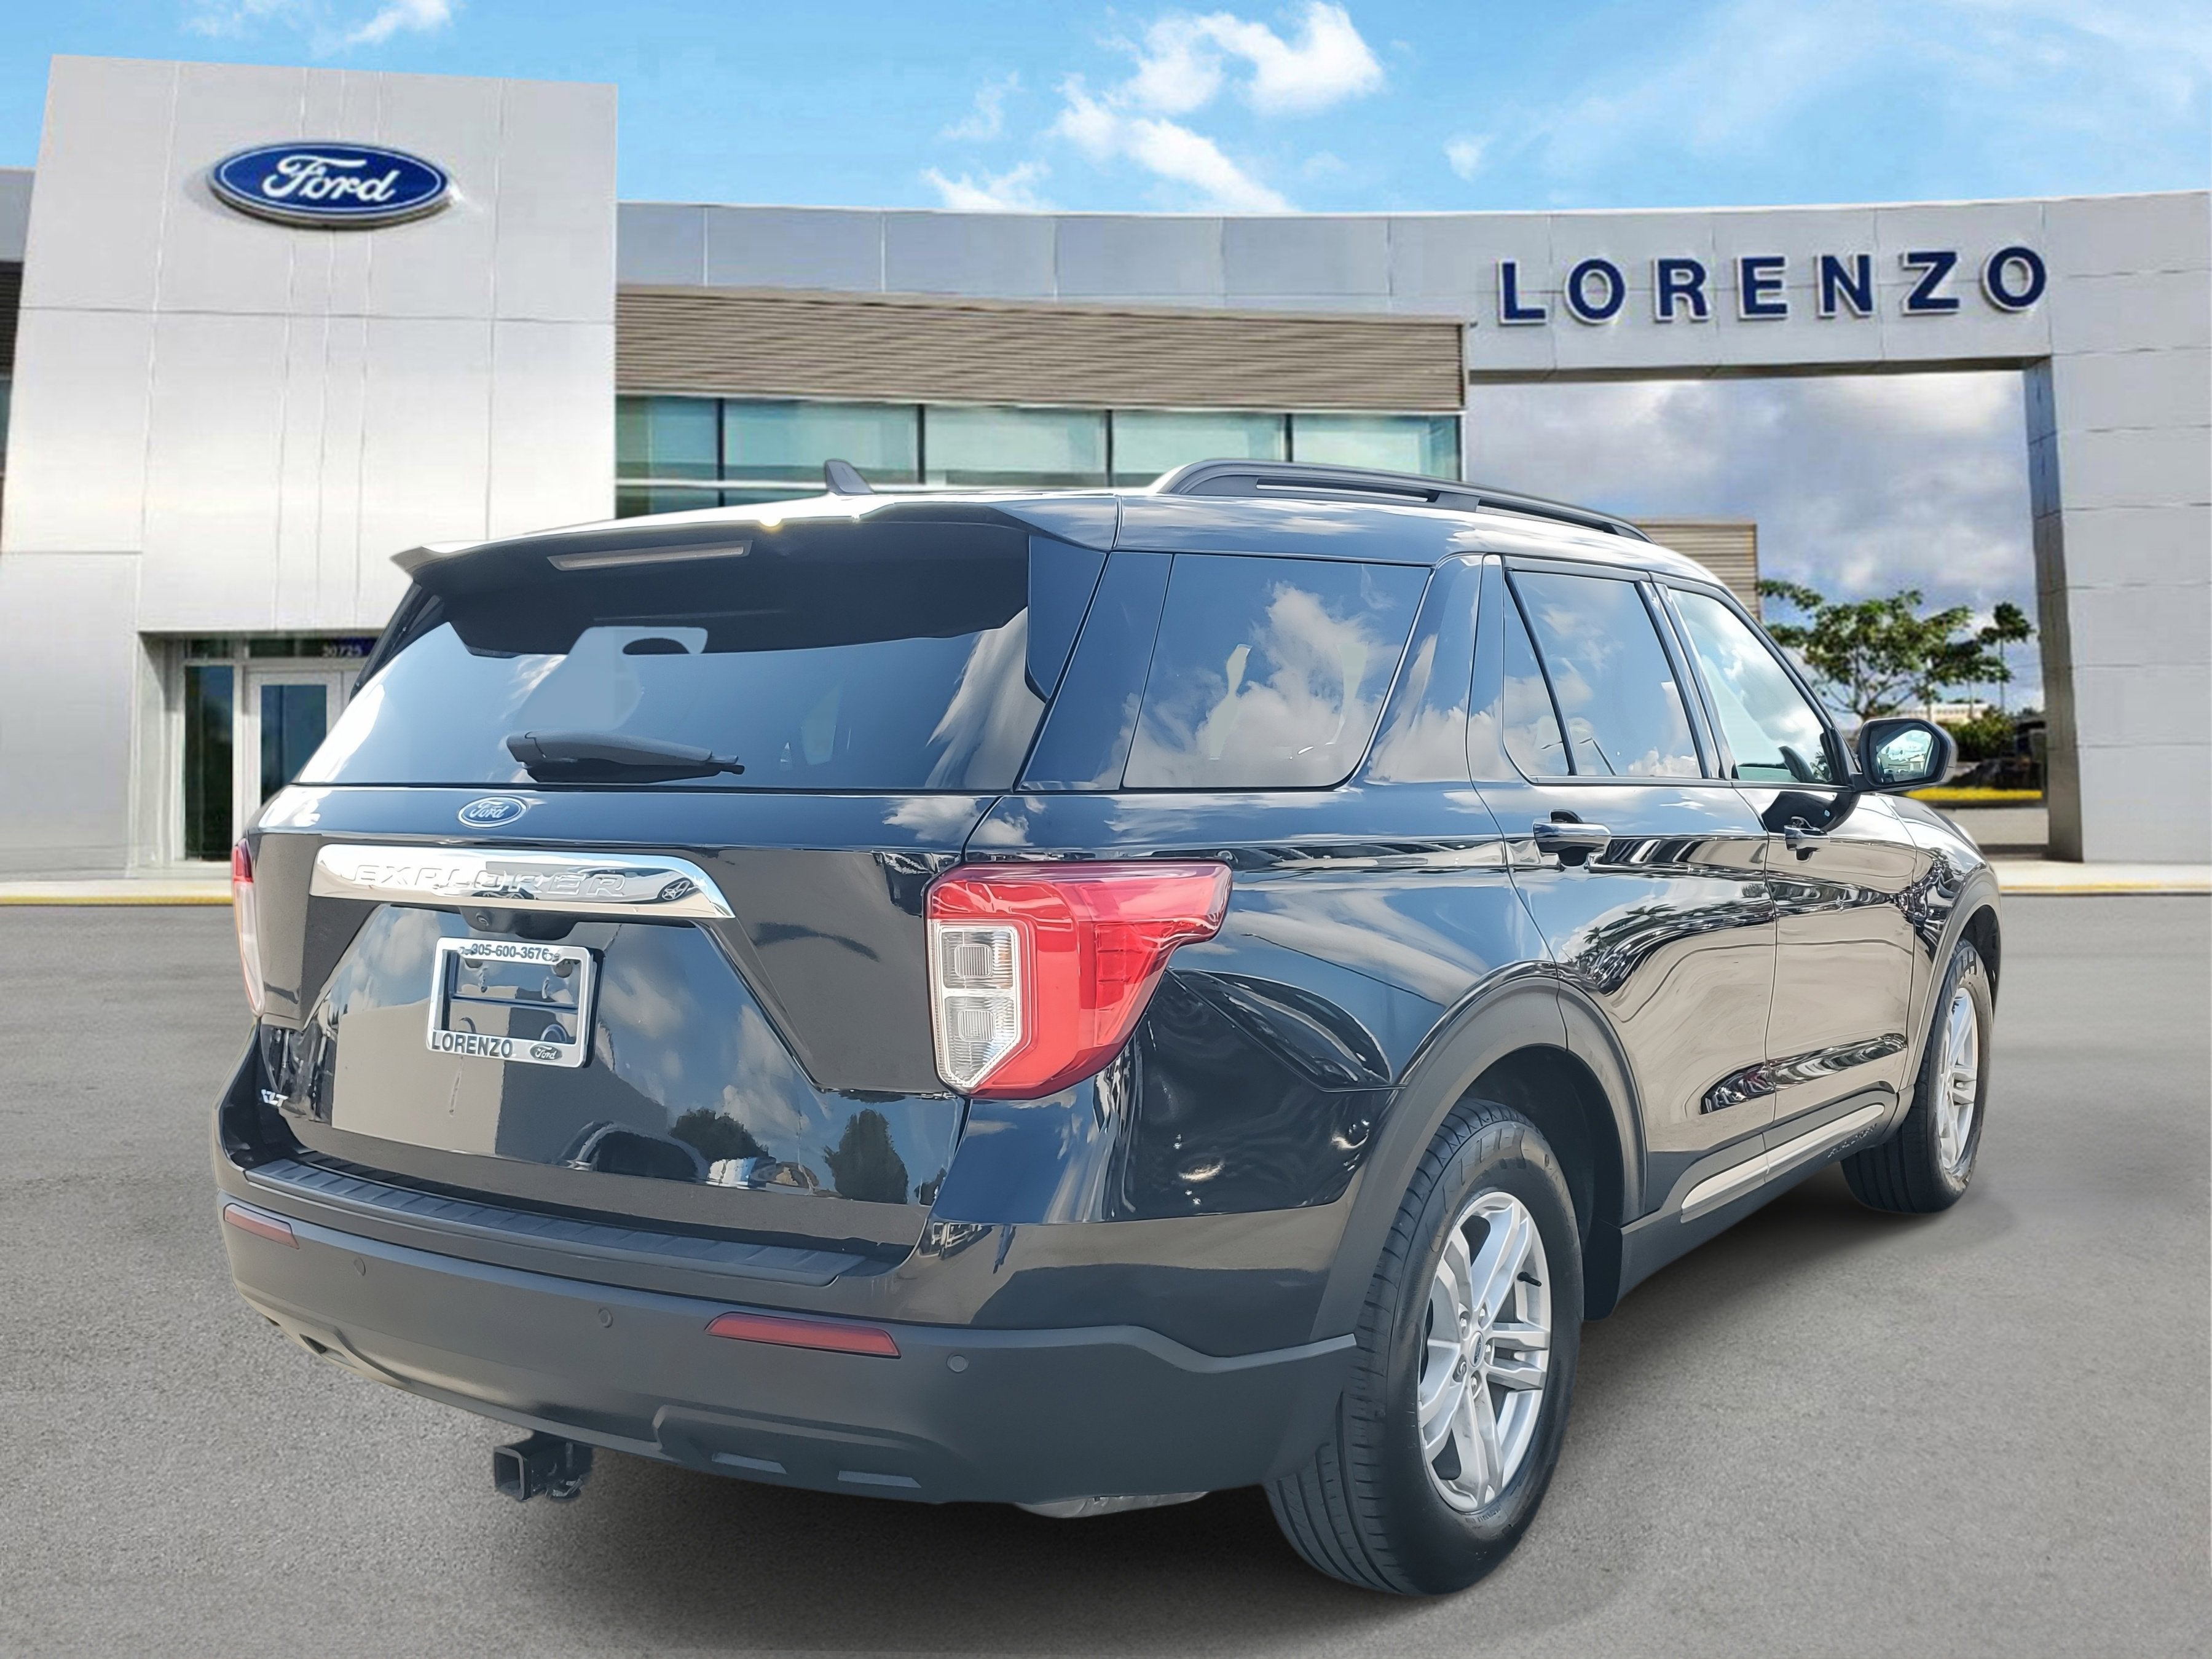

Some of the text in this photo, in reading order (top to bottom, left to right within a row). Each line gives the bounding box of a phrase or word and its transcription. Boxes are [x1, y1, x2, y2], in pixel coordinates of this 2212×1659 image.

[262, 154, 401, 202] Ford
[1500, 246, 2047, 321] LORENZO
[469, 800, 510, 819] Ford
[354, 864, 625, 897] EXPLORER
[431, 1031, 514, 1058] LORENZO
[535, 1046, 557, 1060] Ford
